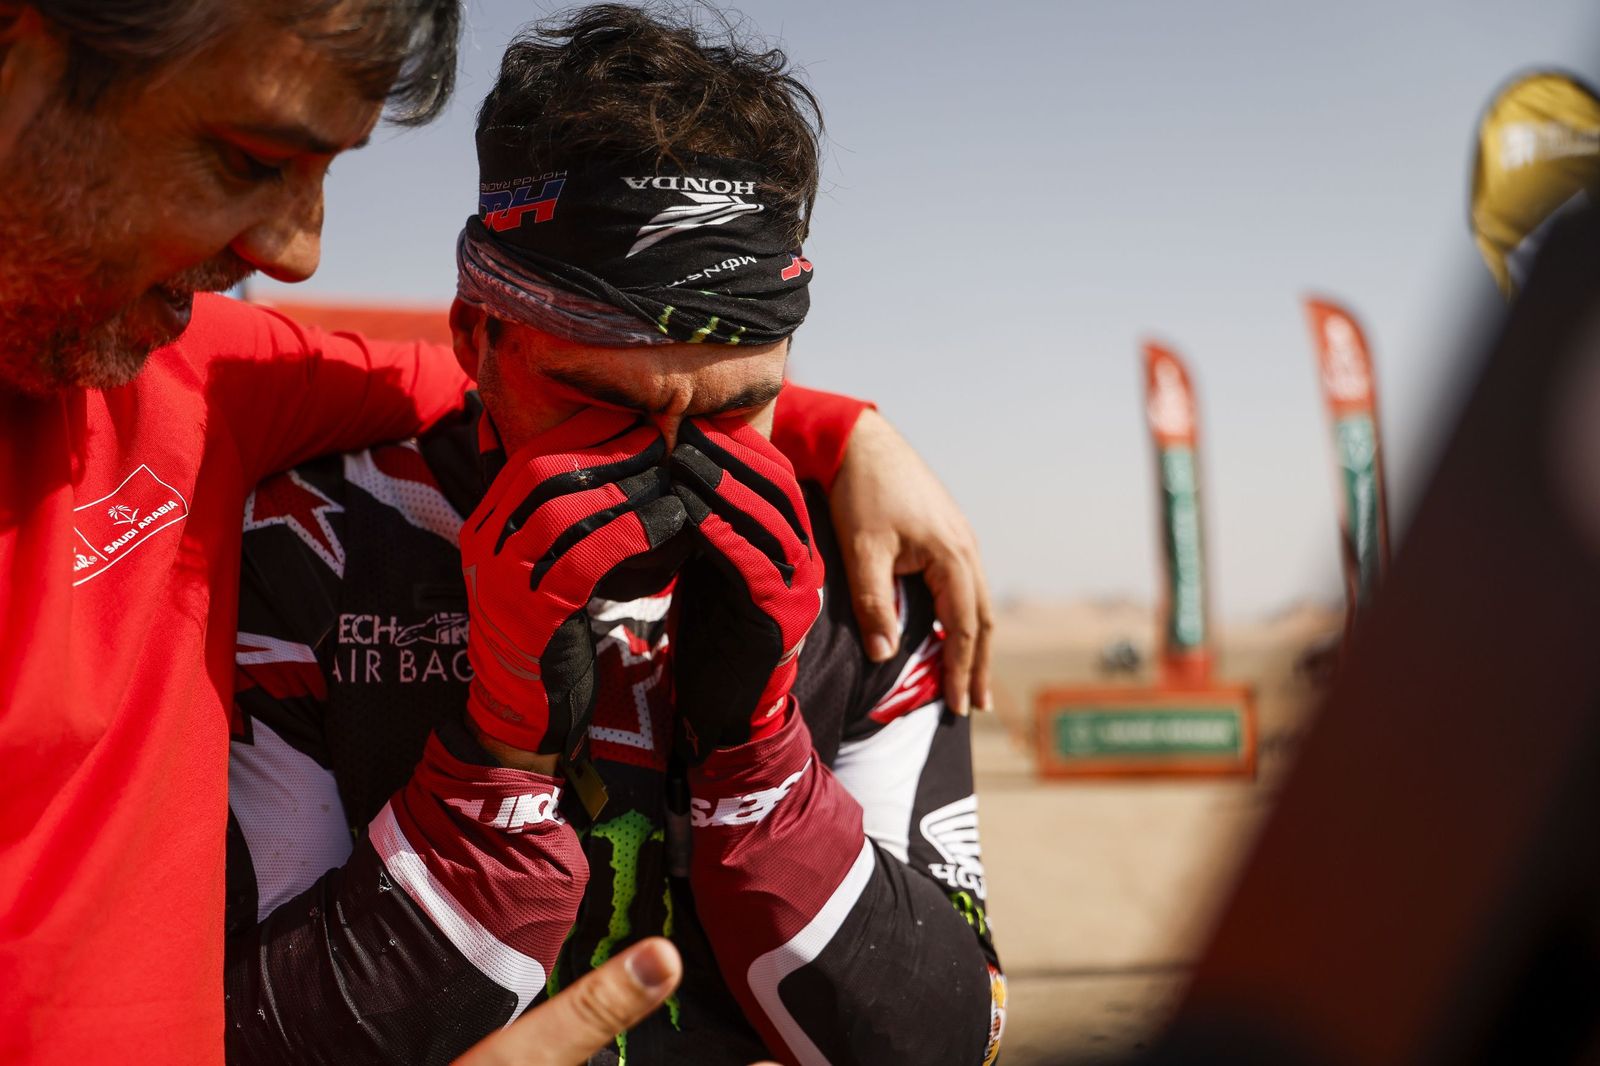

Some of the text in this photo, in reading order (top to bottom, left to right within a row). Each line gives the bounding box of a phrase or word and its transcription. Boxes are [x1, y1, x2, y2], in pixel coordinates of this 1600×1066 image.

[512, 170, 568, 187] Honda
[620, 176, 756, 195] HONDA
[103, 500, 179, 554] SAUDI ARABIA
[400, 649, 476, 682] BAG
